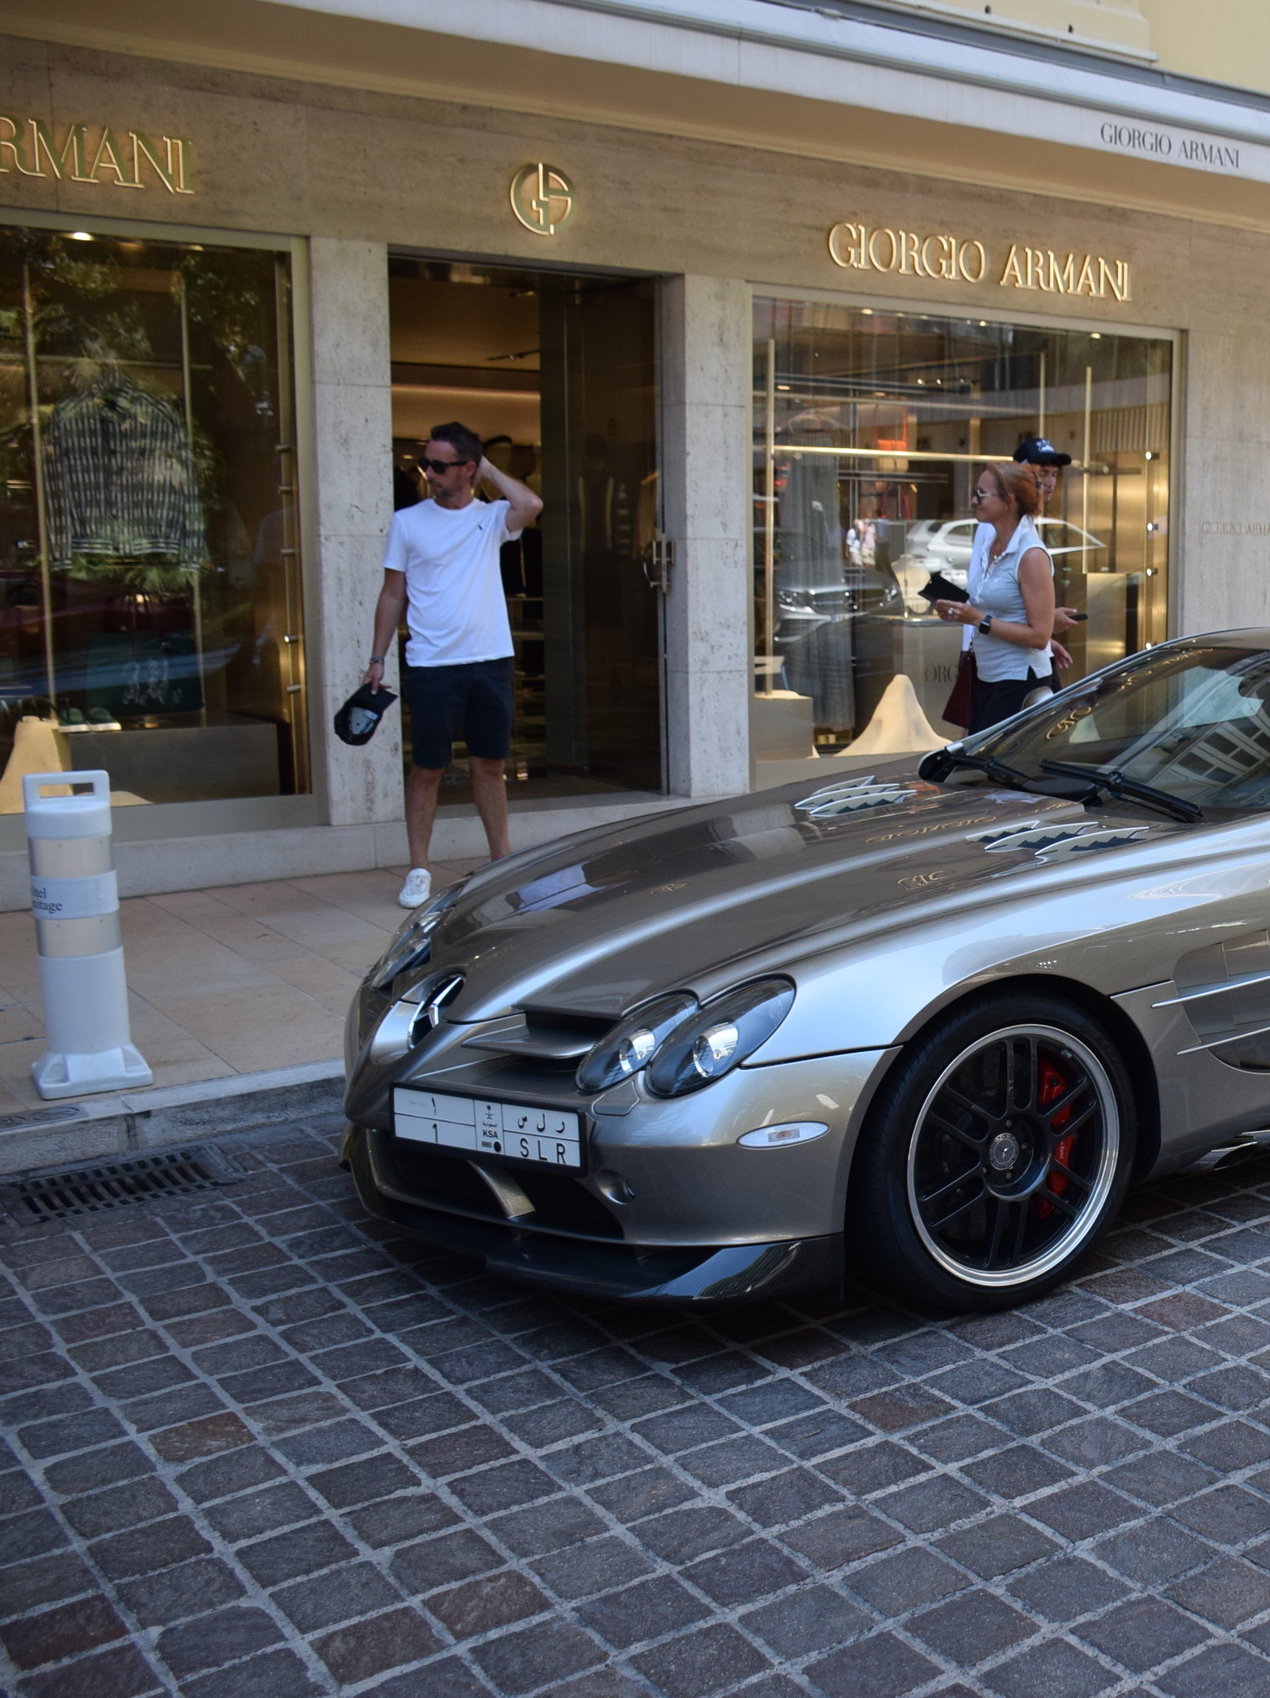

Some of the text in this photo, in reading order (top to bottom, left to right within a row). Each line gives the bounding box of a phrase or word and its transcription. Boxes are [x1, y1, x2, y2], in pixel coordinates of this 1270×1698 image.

[1100, 122, 1240, 169] GIORGIO ARMANI
[828, 222, 1131, 302] GIORGIO ARMANI
[482, 1129, 499, 1139] KSA
